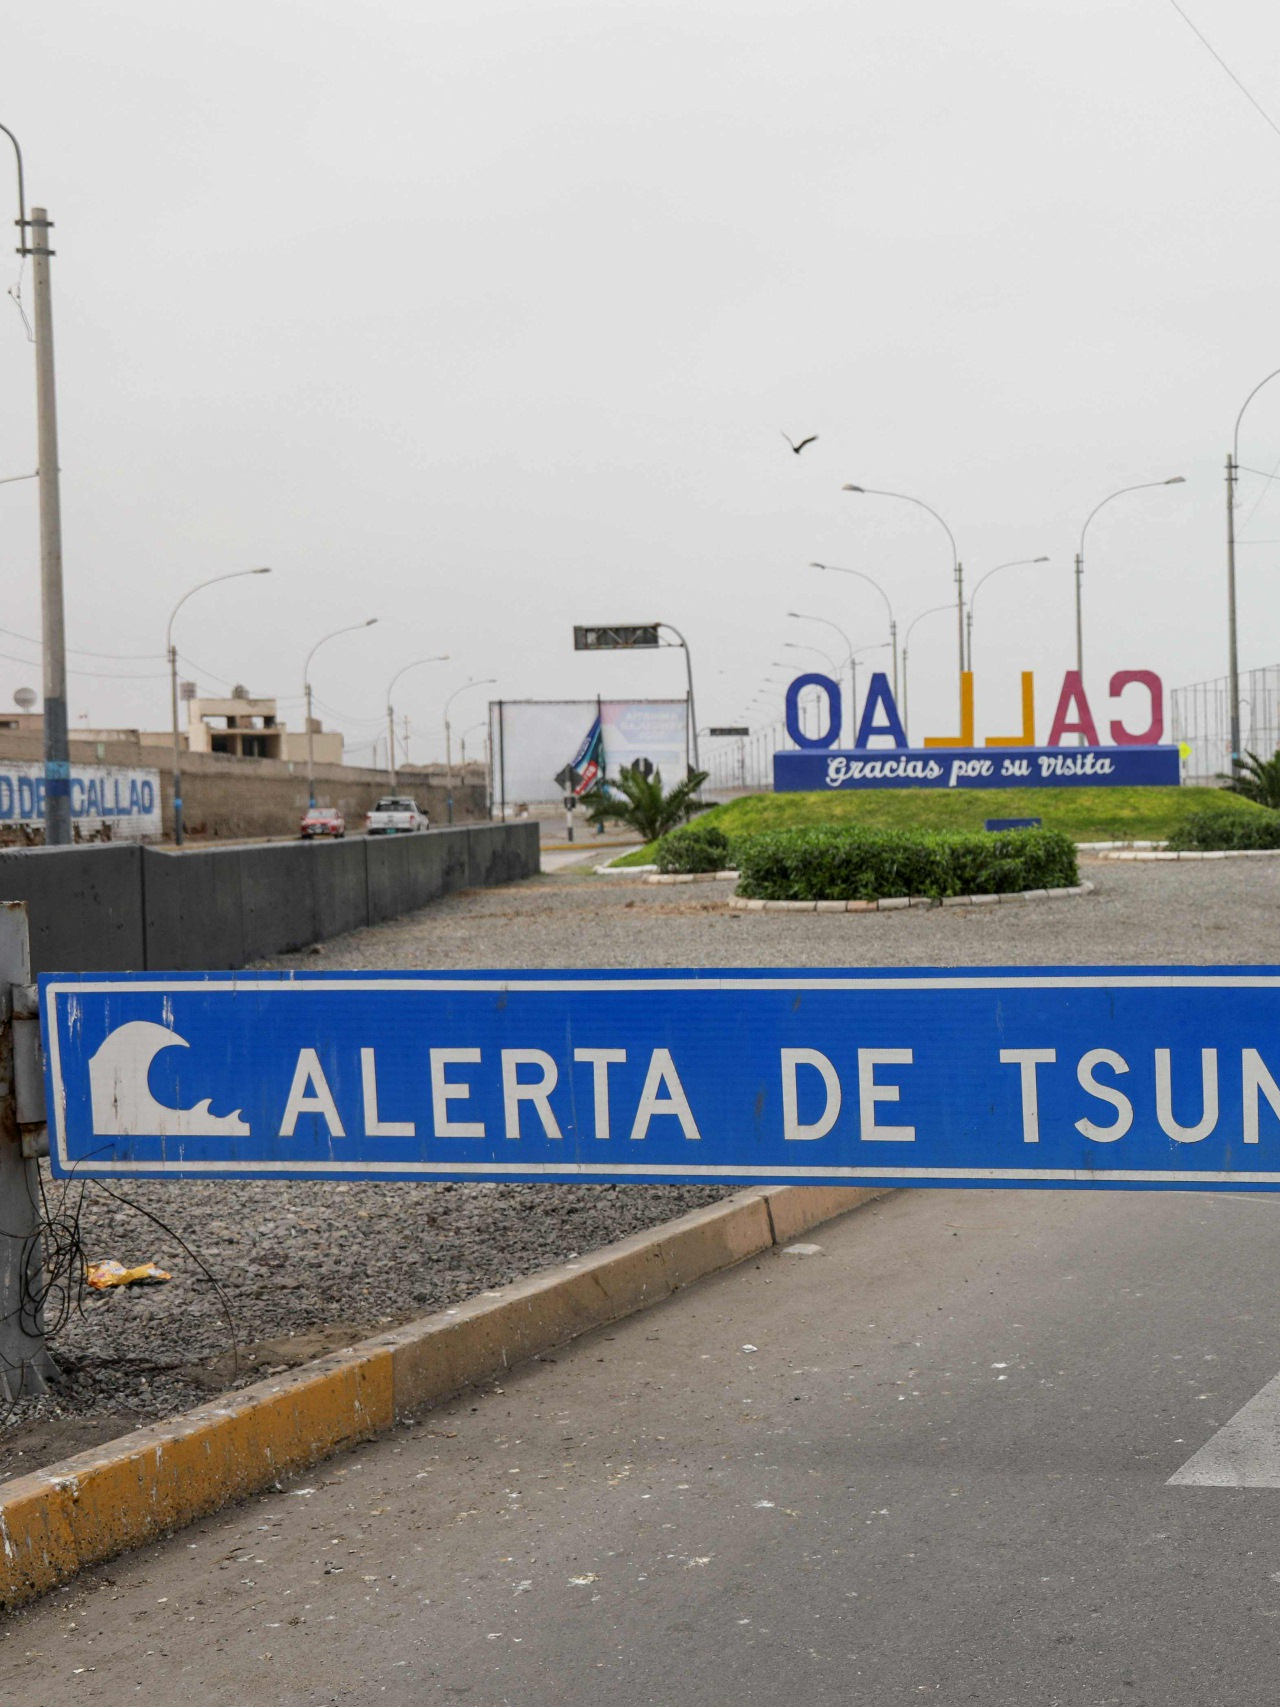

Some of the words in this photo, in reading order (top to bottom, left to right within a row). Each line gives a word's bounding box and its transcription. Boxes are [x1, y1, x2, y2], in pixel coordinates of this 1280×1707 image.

[825, 756, 943, 787] Gracias
[948, 758, 994, 787] por
[1000, 758, 1032, 775] su
[1038, 753, 1115, 777] visita
[18, 776, 46, 819] DE
[70, 778, 154, 818] CALLAO
[278, 1047, 701, 1141] ALERTA
[780, 1047, 915, 1142] DE
